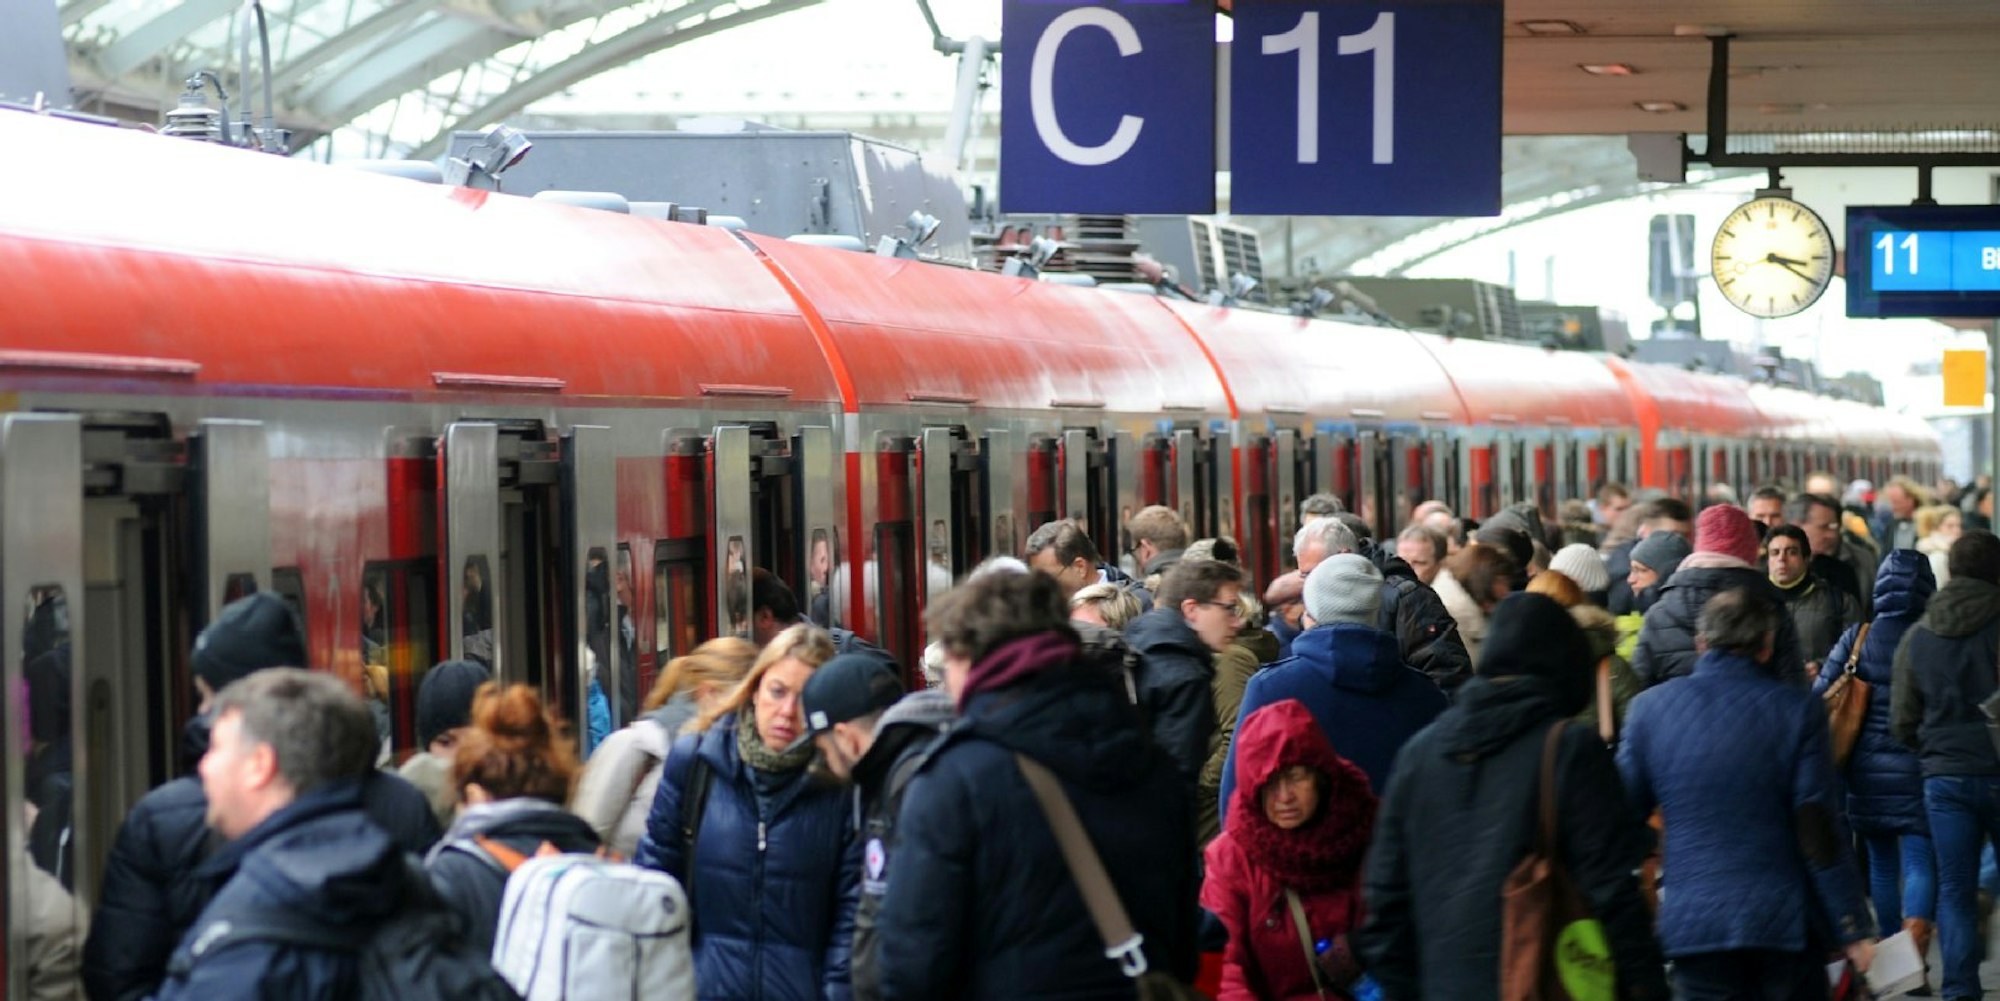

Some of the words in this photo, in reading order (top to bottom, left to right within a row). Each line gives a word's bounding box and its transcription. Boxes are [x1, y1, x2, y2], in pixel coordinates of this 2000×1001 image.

[1030, 6, 1144, 166] C
[1261, 11, 1396, 165] 11
[1875, 233, 1919, 275] 11
